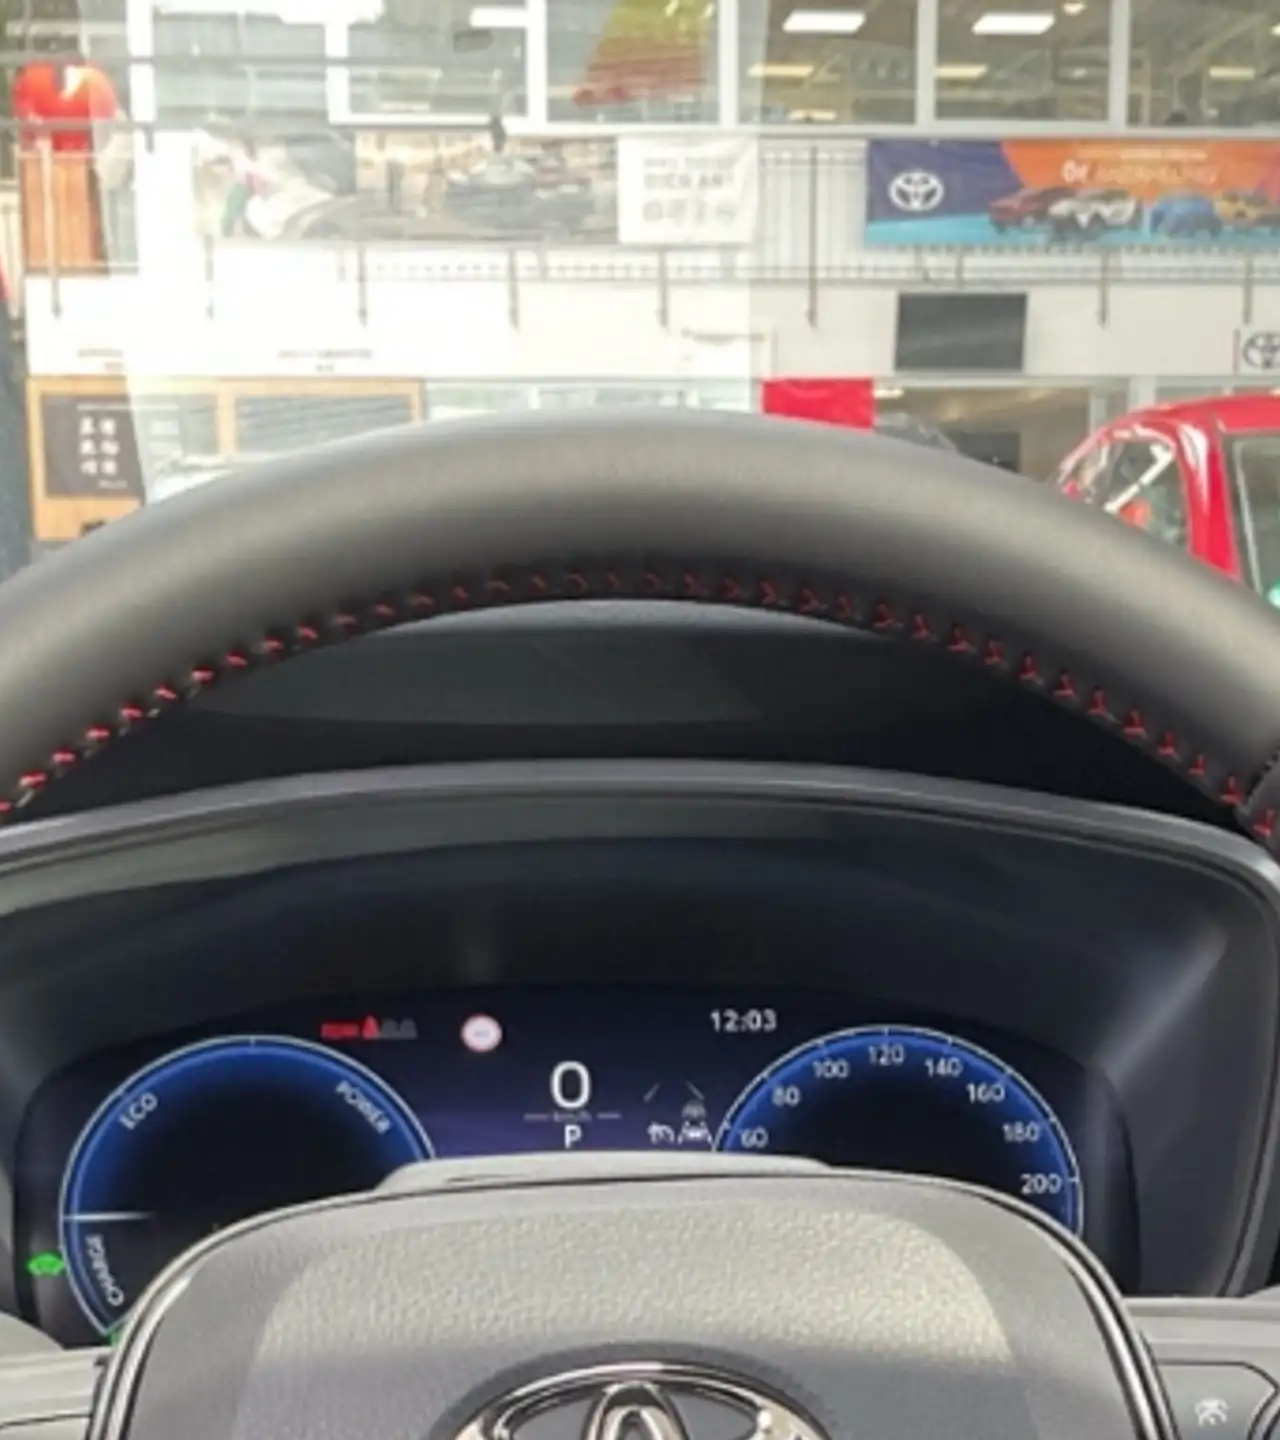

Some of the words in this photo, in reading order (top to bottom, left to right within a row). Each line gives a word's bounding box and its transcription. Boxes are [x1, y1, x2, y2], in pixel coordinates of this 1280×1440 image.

[710, 1009, 777, 1032] 12:03
[868, 1045, 905, 1066] 120
[812, 1059, 850, 1079] 100
[924, 1057, 963, 1078] 140
[551, 1060, 592, 1109] 0
[966, 1083, 1005, 1103] 160
[772, 1086, 800, 1107] 80
[118, 1092, 158, 1131] ECO
[334, 1080, 392, 1135] POWER
[564, 1124, 582, 1148] P
[740, 1127, 768, 1148] 60
[1002, 1122, 1041, 1143] 180
[1021, 1173, 1062, 1195] 200
